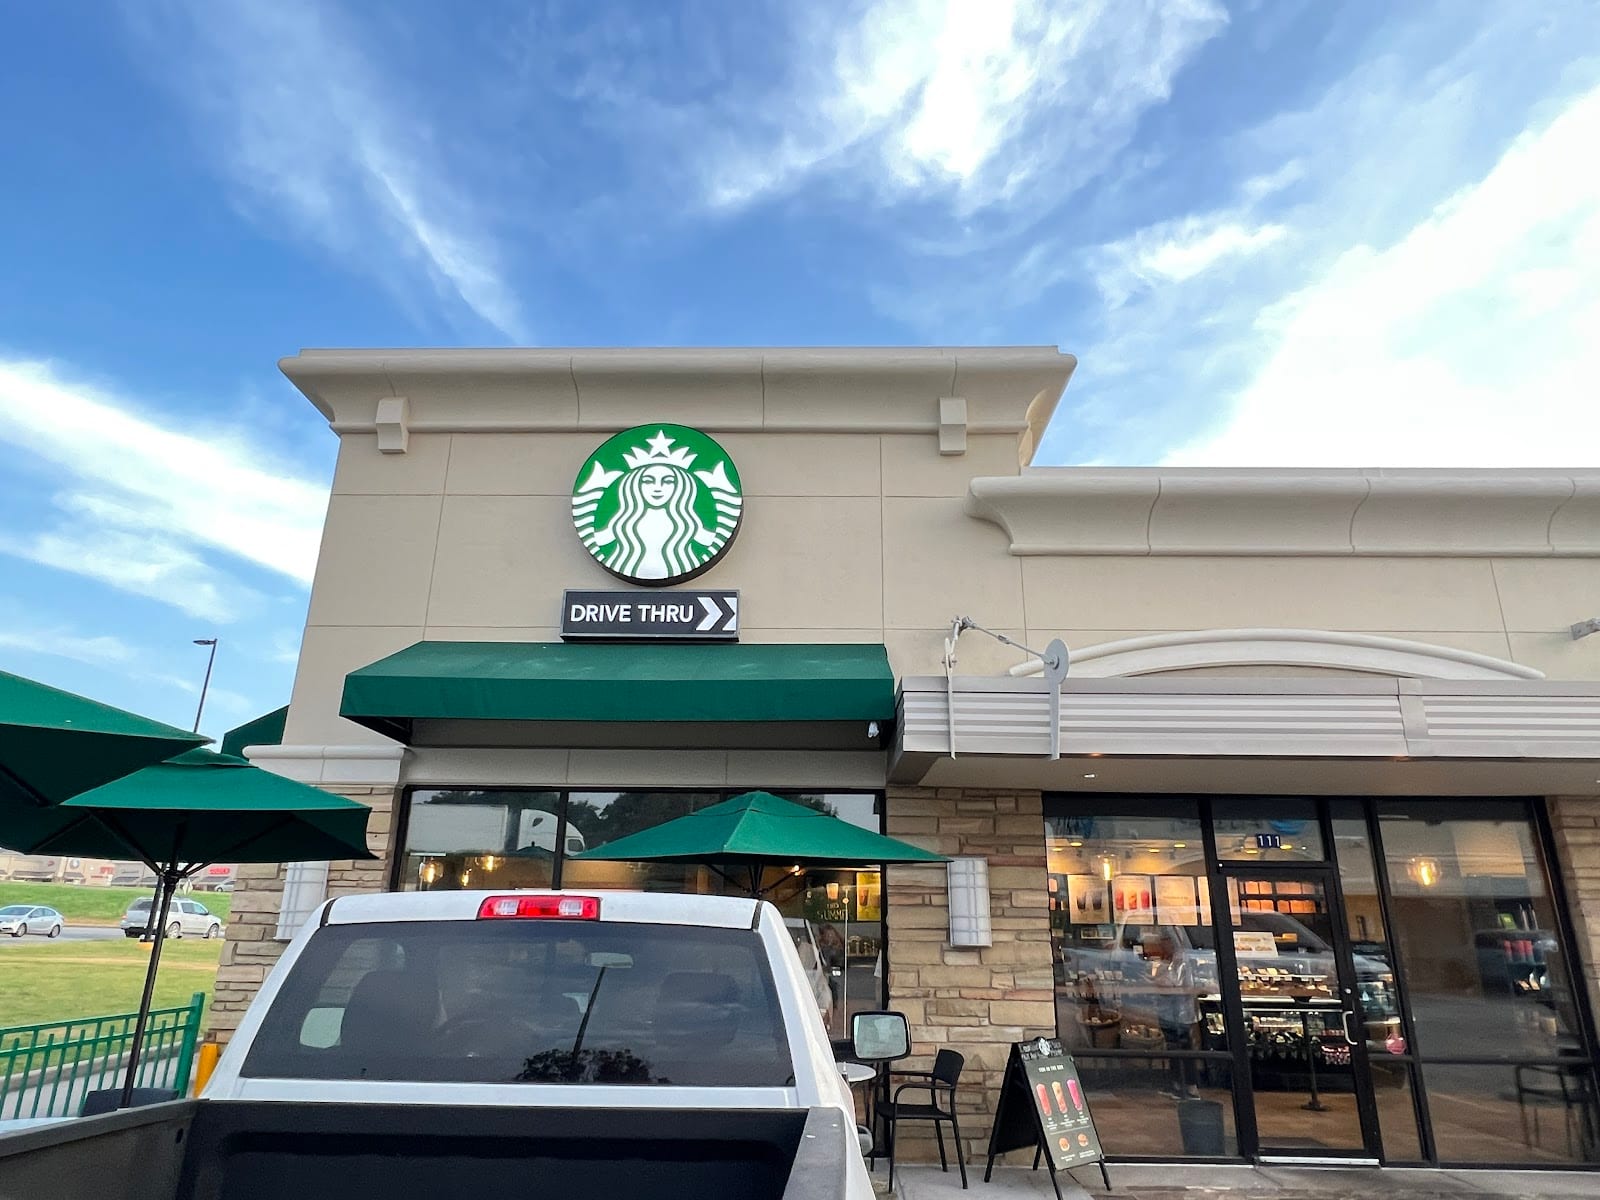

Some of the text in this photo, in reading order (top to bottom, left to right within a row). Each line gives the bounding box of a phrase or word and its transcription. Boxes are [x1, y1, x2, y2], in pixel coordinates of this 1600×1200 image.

[570, 604, 694, 622] DRIVE THRU
[1258, 835, 1280, 847] 111
